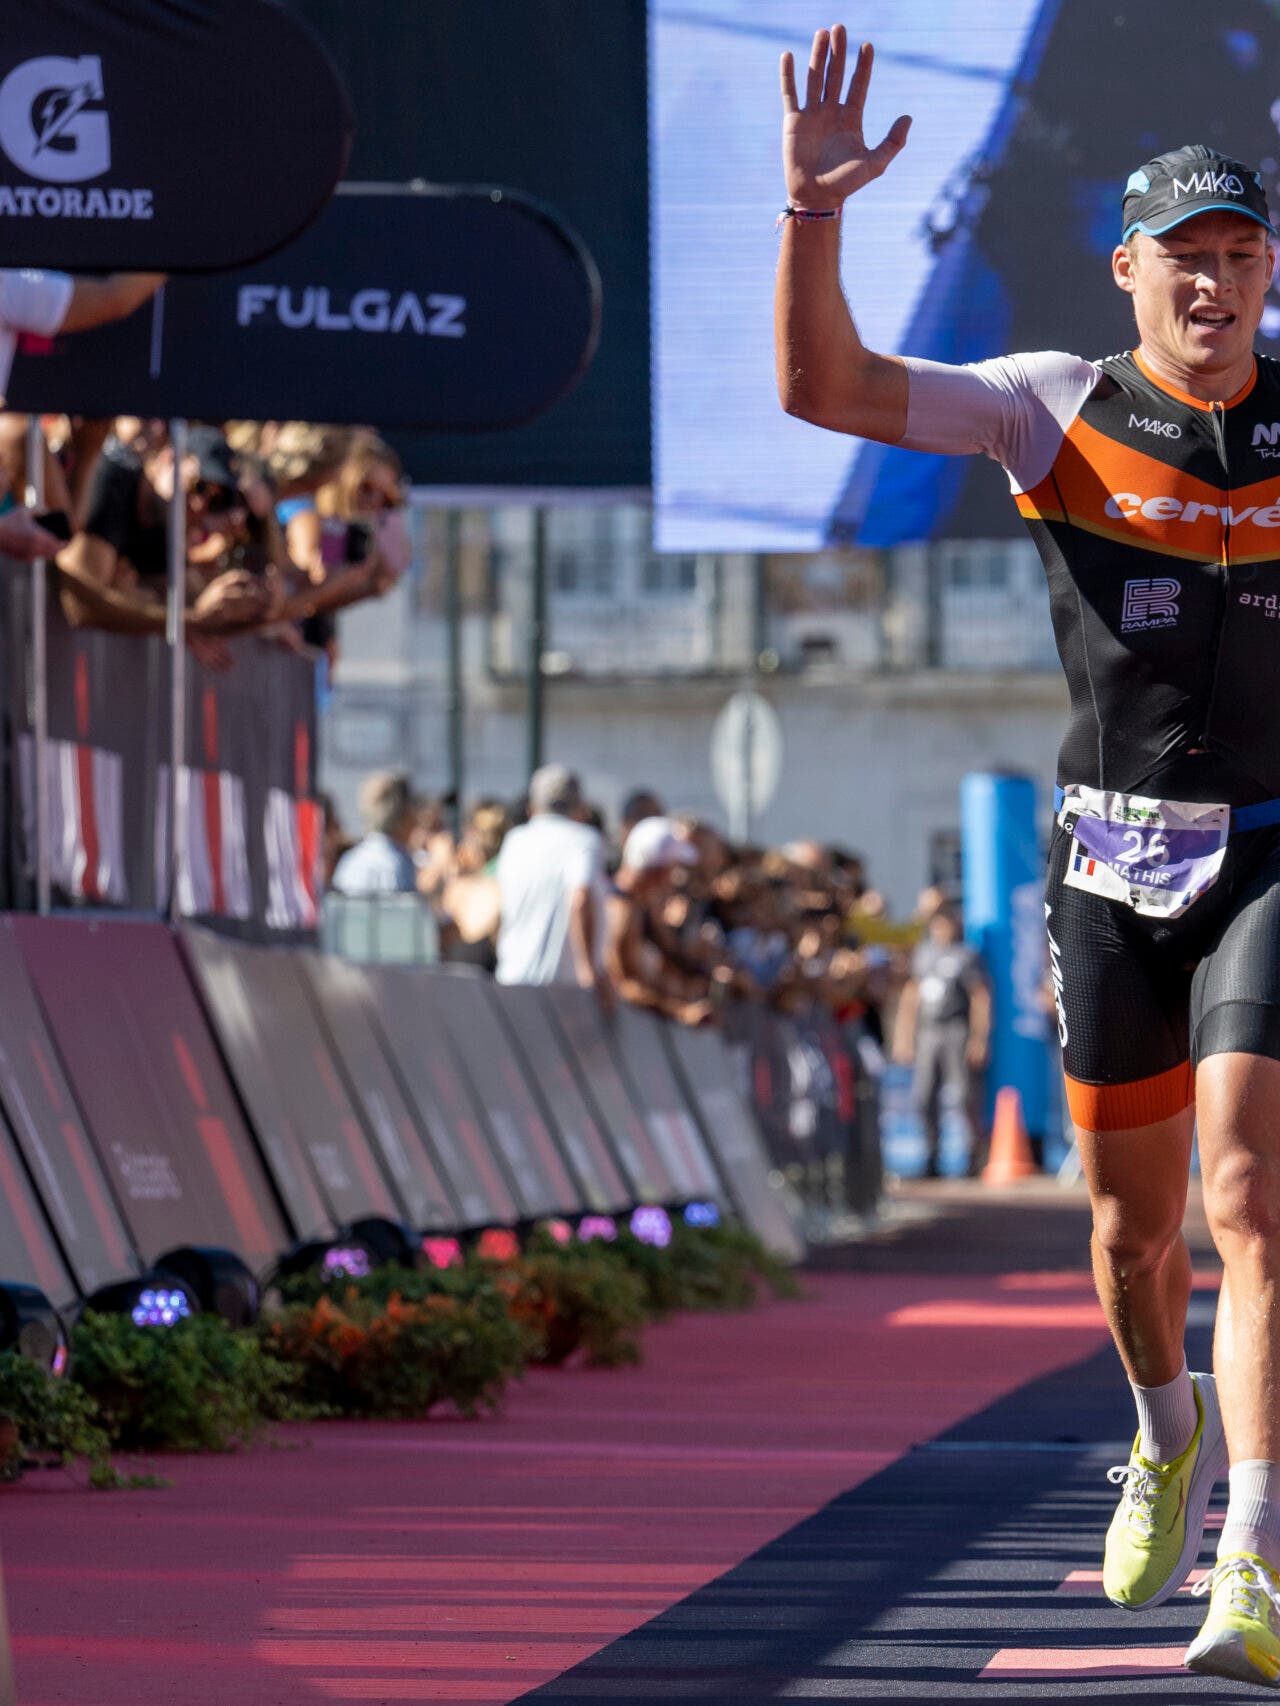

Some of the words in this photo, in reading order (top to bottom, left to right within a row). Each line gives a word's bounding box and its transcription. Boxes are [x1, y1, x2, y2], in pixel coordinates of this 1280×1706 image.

[1173, 170, 1244, 200] MAKO
[236, 284, 467, 338] FULGAZ
[1128, 413, 1182, 439] MAKO
[1120, 616, 1177, 631] RAMPA
[1264, 609, 1276, 618] LE
[1115, 830, 1170, 868] 26
